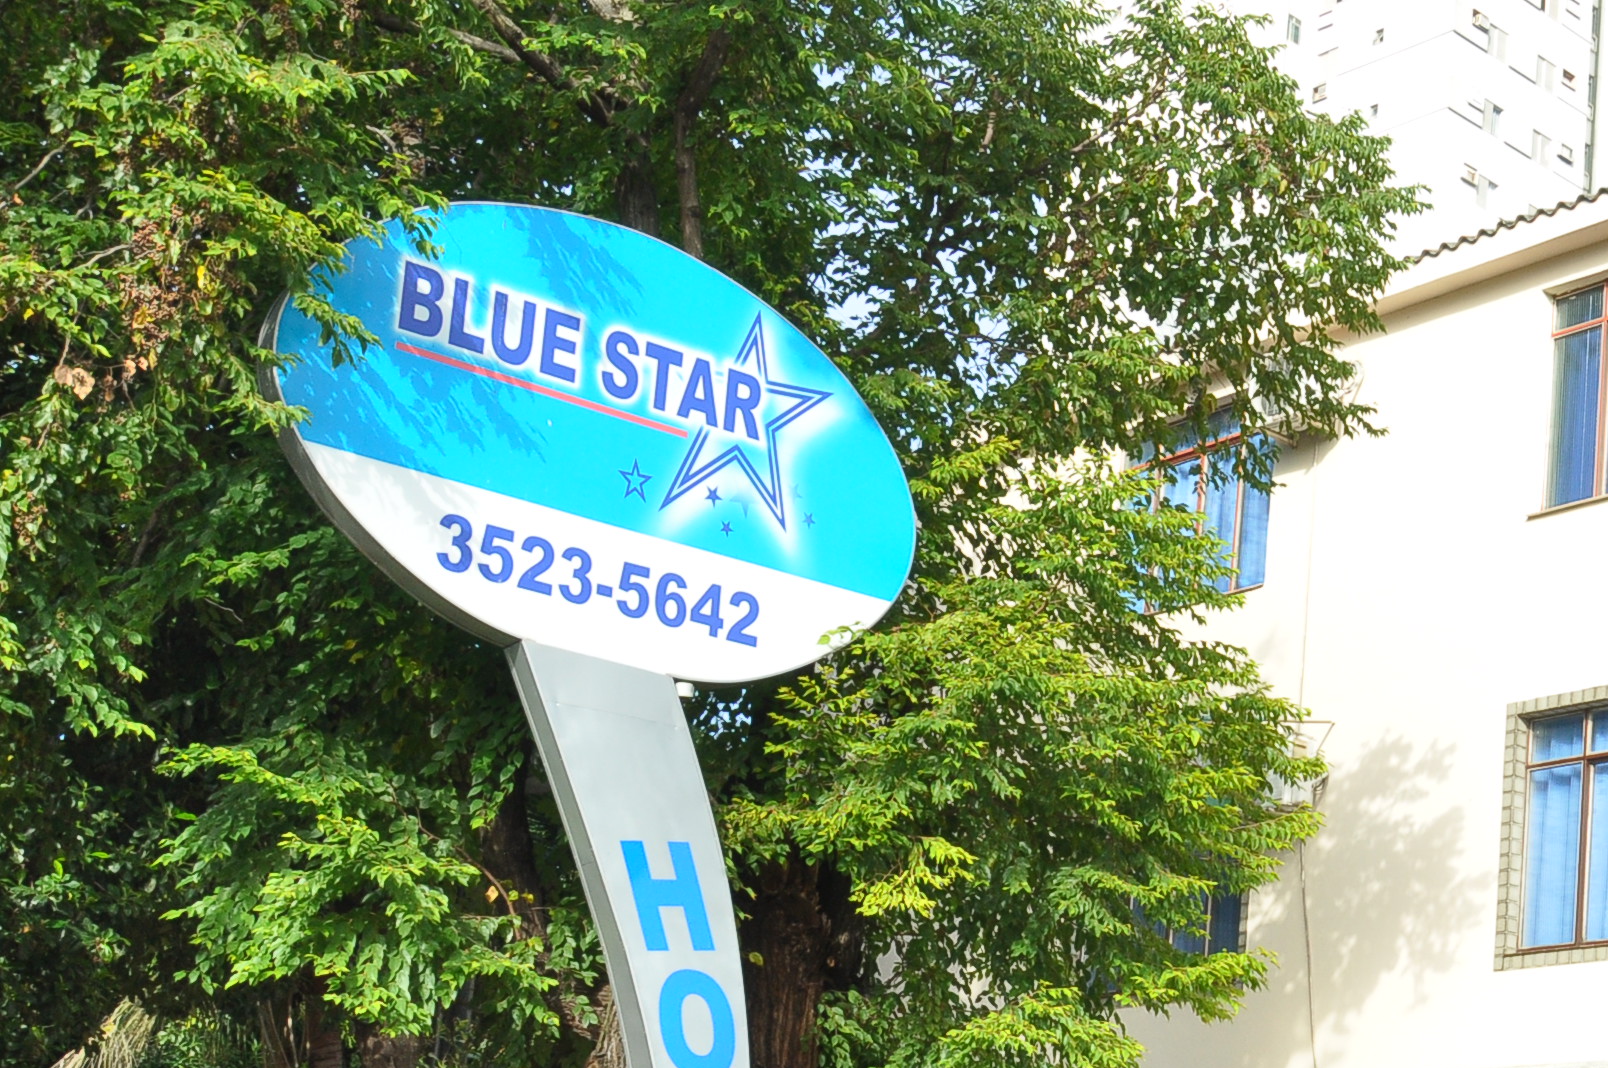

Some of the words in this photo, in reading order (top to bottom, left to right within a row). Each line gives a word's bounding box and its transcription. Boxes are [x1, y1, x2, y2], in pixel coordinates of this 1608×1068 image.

[397, 260, 581, 383] BLUE
[601, 331, 763, 441] STAR
[436, 513, 761, 648] 3523-5642
